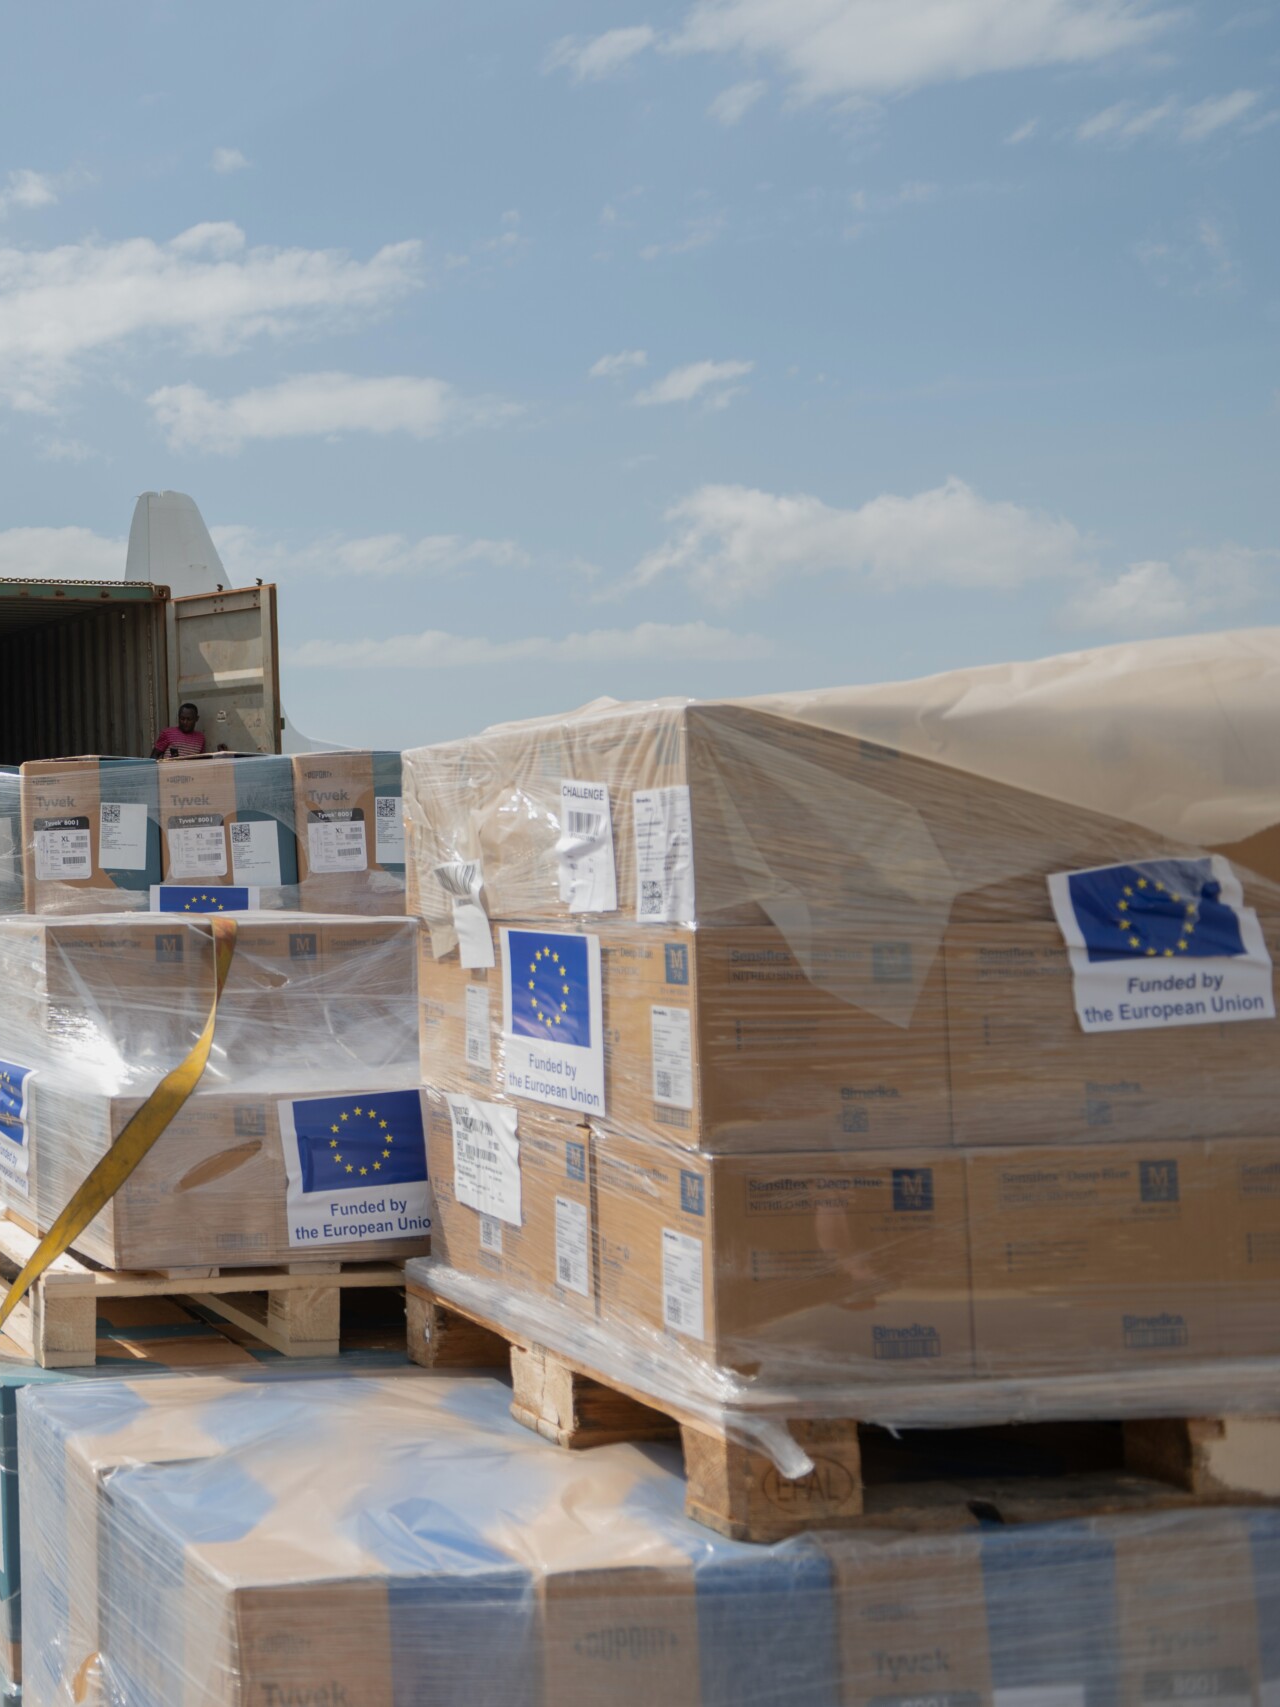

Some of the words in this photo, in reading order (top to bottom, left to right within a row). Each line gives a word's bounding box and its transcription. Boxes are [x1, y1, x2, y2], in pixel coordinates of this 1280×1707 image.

[170, 794, 210, 810] Tyvek
[308, 789, 349, 804] Tyvek
[562, 785, 605, 801] CHALLENGE
[35, 795, 75, 811] Tyvek
[162, 938, 176, 953] M
[296, 938, 310, 951] M
[671, 950, 684, 970] M
[731, 949, 791, 963] Sensiflex
[1127, 974, 1197, 993] Funded
[1202, 972, 1224, 991] by
[1084, 1006, 1114, 1024] the
[1117, 1001, 1207, 1021] European
[1211, 995, 1265, 1013] Union
[529, 1053, 563, 1075] Funded
[565, 1064, 577, 1081] by
[508, 1073, 523, 1088] the
[525, 1075, 568, 1099] European
[570, 1086, 600, 1106] Union
[686, 1176, 700, 1195] M
[749, 1177, 808, 1191] Sensiflex
[816, 1178, 851, 1191] Deep
[903, 1176, 926, 1195] M
[1147, 1167, 1169, 1186] M
[330, 1199, 386, 1217] Funded
[390, 1199, 408, 1213] by
[295, 1225, 319, 1240] the
[323, 1220, 394, 1237] European
[398, 1216, 432, 1231] Unio
[870, 1648, 950, 1681] Tyvek
